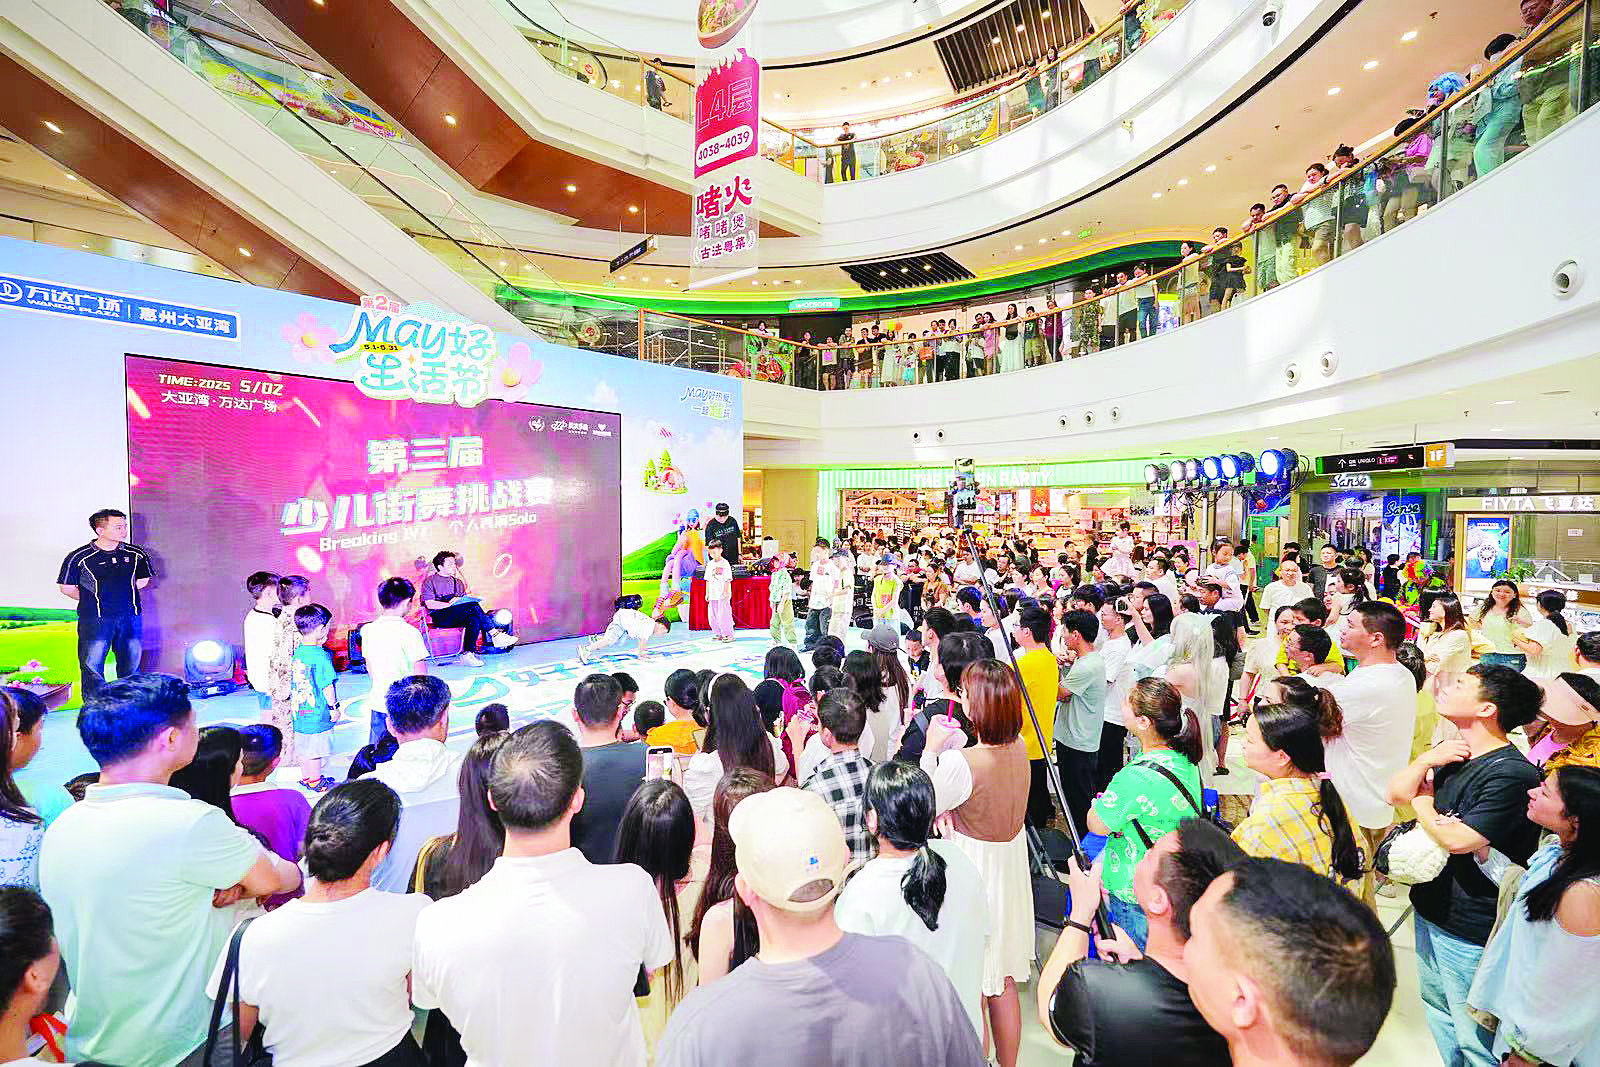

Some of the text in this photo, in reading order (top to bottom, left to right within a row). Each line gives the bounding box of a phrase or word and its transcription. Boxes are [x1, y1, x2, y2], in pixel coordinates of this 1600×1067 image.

[696, 76, 753, 131] L4层
[26, 285, 121, 312] 万达广场
[27, 299, 120, 318] WANDA PLAZA
[361, 294, 401, 315] 第2届
[139, 306, 231, 334] 惠州大亚湾
[158, 374, 284, 396] TIME:2025 5/02
[360, 353, 484, 399] 生活节
[367, 435, 484, 475] 第三届
[1358, 457, 1375, 465] UNIQLO
[1430, 449, 1444, 462] 1F
[1482, 496, 1535, 511] FIYTA
[319, 530, 399, 552] Breaking
